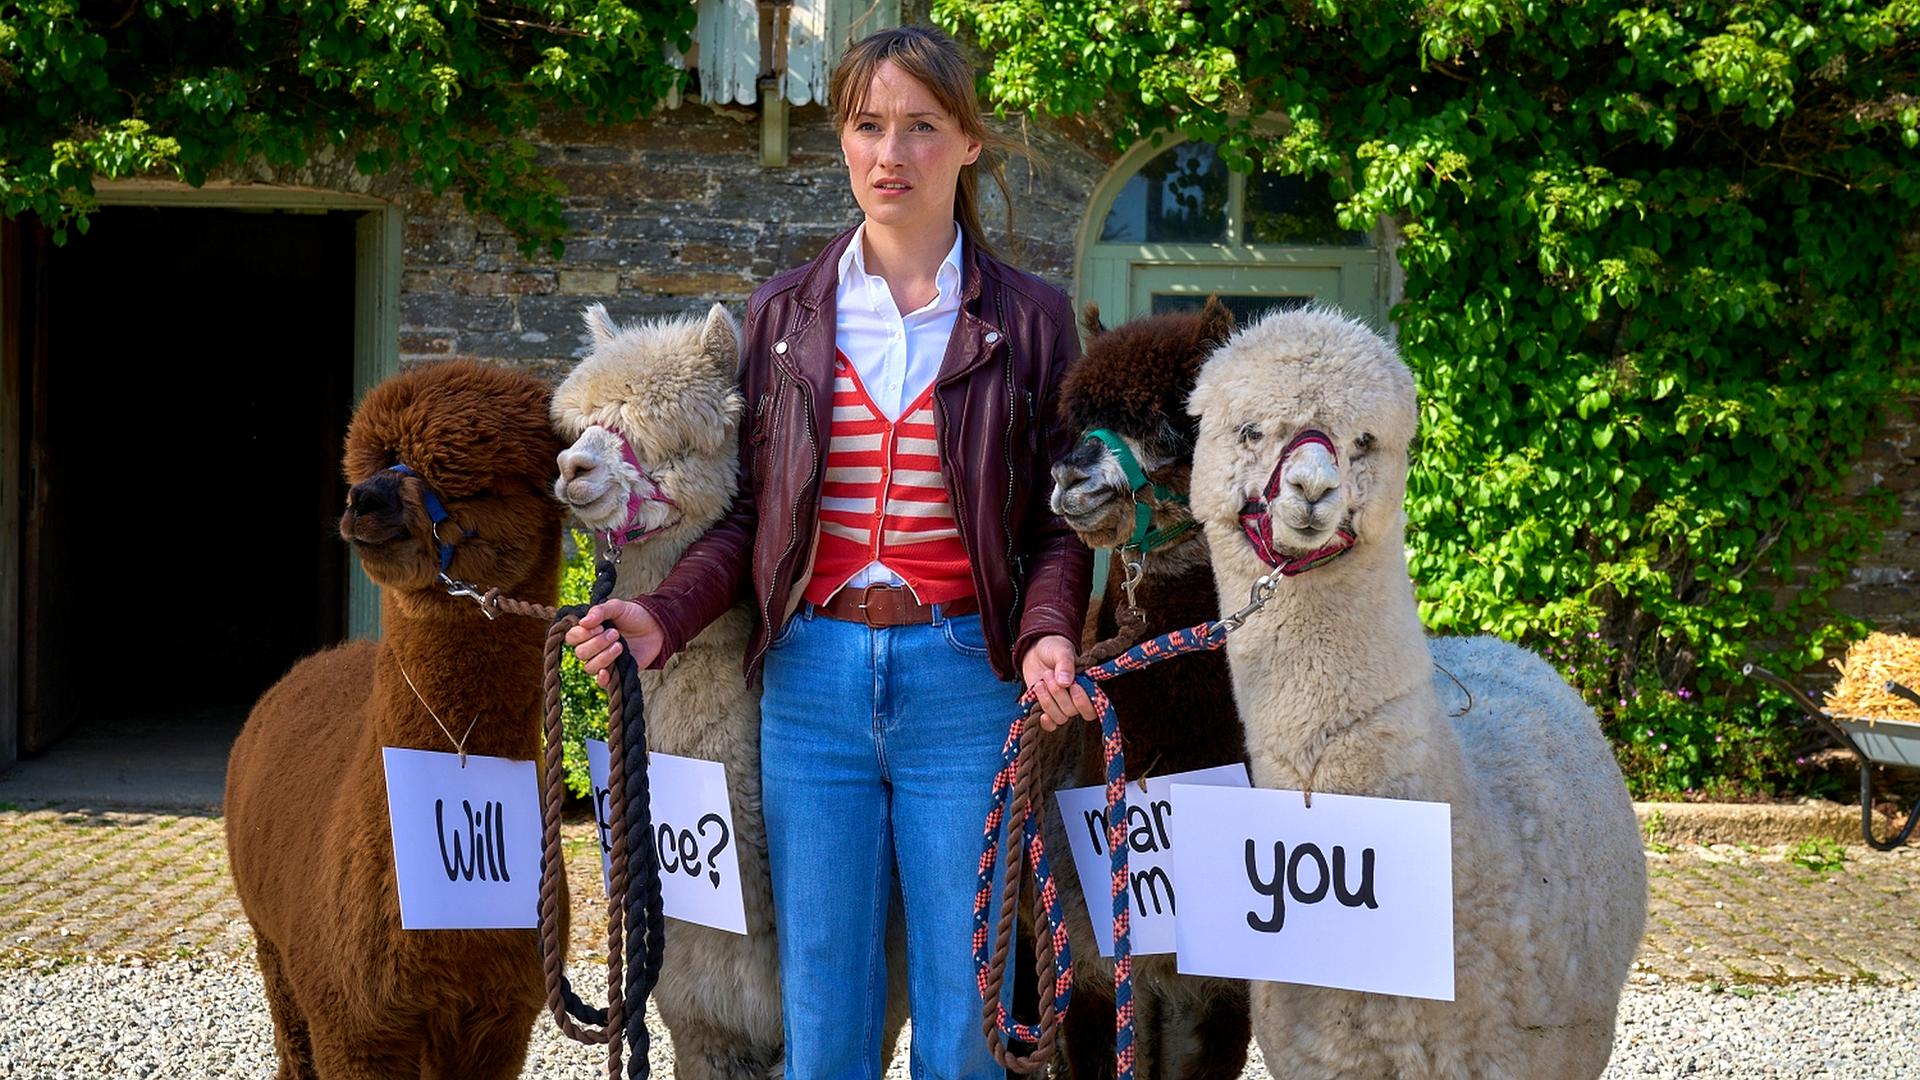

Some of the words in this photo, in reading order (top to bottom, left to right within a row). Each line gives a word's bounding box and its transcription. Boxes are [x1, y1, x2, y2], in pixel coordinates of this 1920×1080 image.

[435, 798, 511, 882] Will
[595, 785, 730, 890] Bce?
[1084, 799, 1172, 856] mar
[1129, 865, 1176, 918] m
[1245, 838, 1379, 933] you
